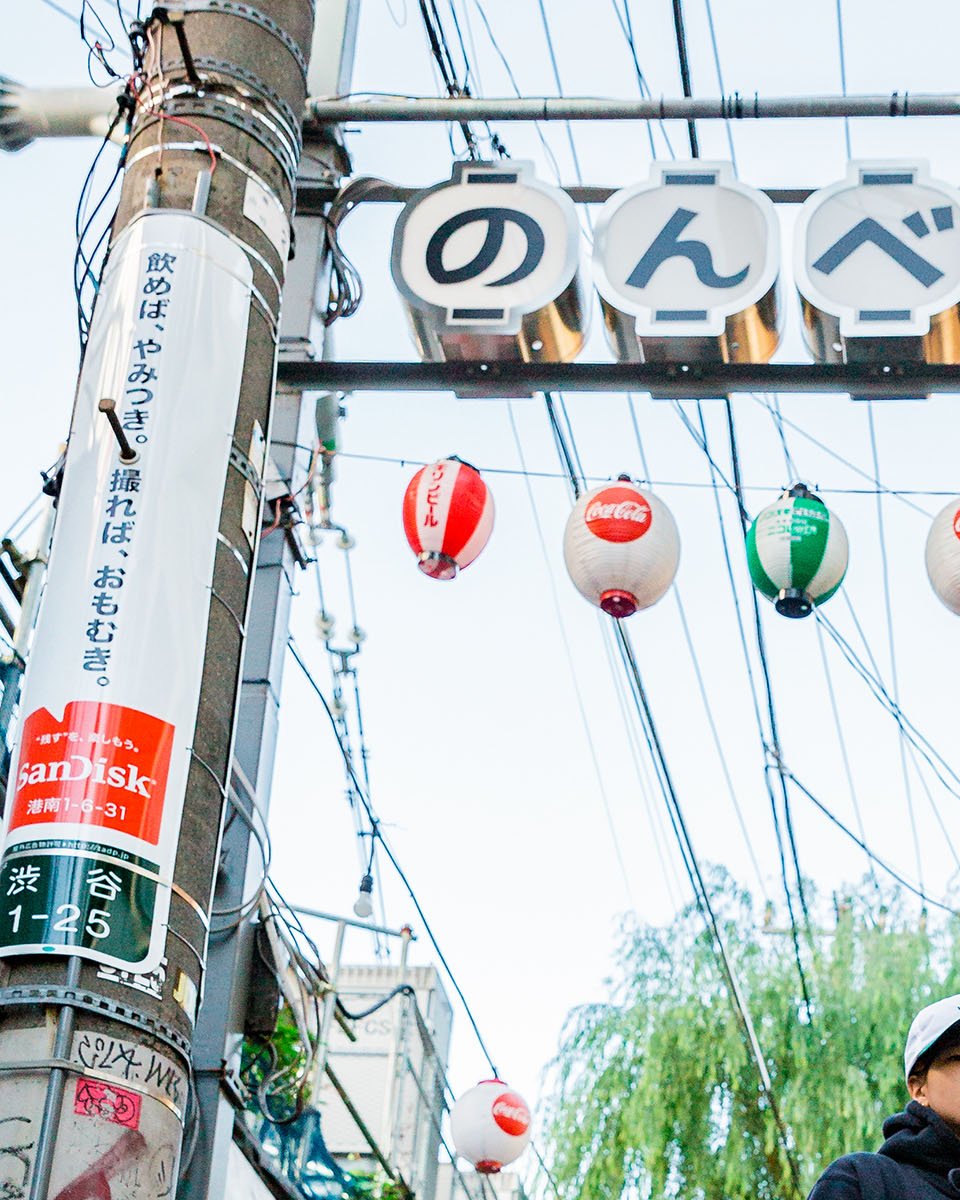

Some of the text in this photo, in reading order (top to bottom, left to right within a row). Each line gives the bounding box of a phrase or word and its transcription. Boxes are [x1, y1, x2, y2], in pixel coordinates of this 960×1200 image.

[17, 755, 152, 798] SanDisk
[26, 797, 127, 821] 港南1-6-31
[6, 864, 123, 901] 渋谷
[7, 903, 112, 939] 1-25
